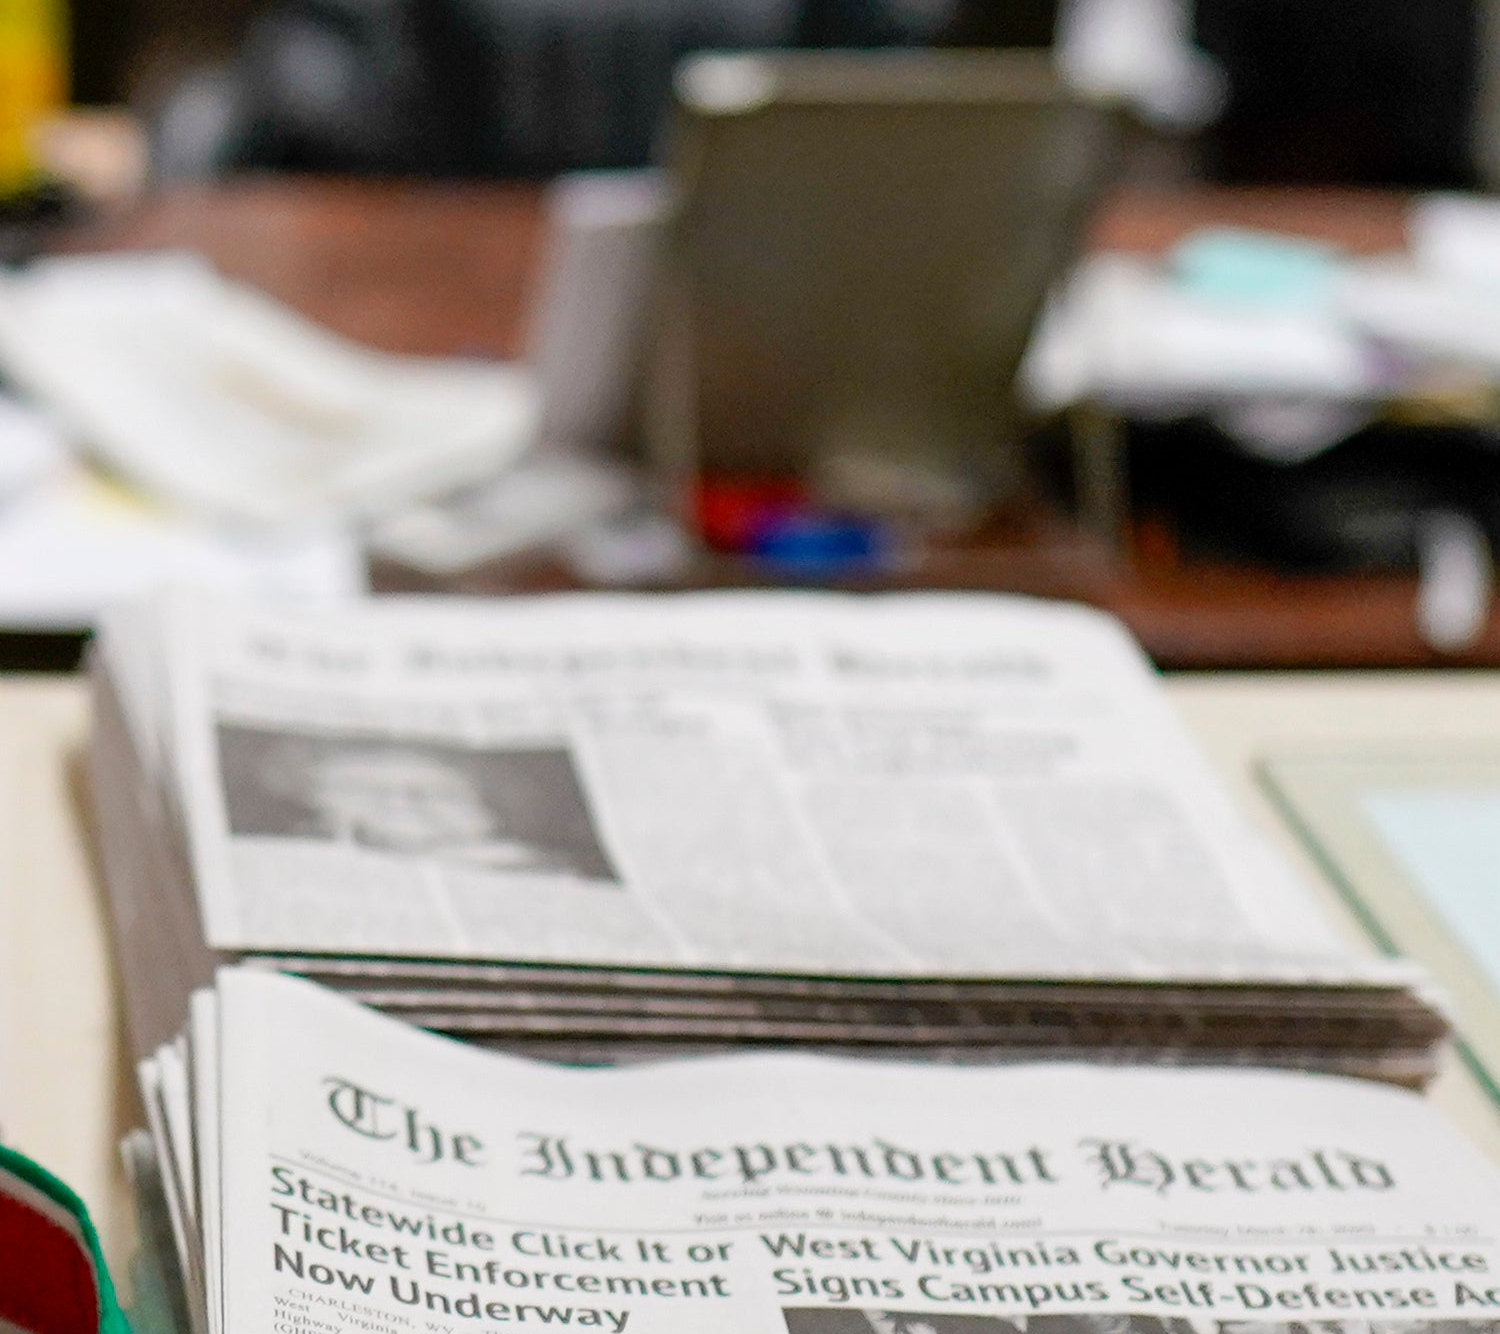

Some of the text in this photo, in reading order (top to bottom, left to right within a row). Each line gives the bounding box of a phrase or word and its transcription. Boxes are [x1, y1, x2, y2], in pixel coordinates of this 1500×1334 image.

[322, 1076, 489, 1167] The
[515, 1130, 1057, 1187] Independent
[1078, 1136, 1397, 1197] Herald
[271, 1167, 495, 1251] Statewide
[511, 1230, 620, 1262] Click
[637, 1239, 673, 1264] It
[688, 1241, 735, 1264] or
[271, 1202, 733, 1298] Ticket Enforcement
[760, 1232, 1489, 1275] West Virginia Governor Justice
[272, 1243, 631, 1333] Now Underway
[772, 1267, 904, 1303] Signs
[918, 1274, 1110, 1309] Campus
[1121, 1275, 1438, 1310] Self-Defense
